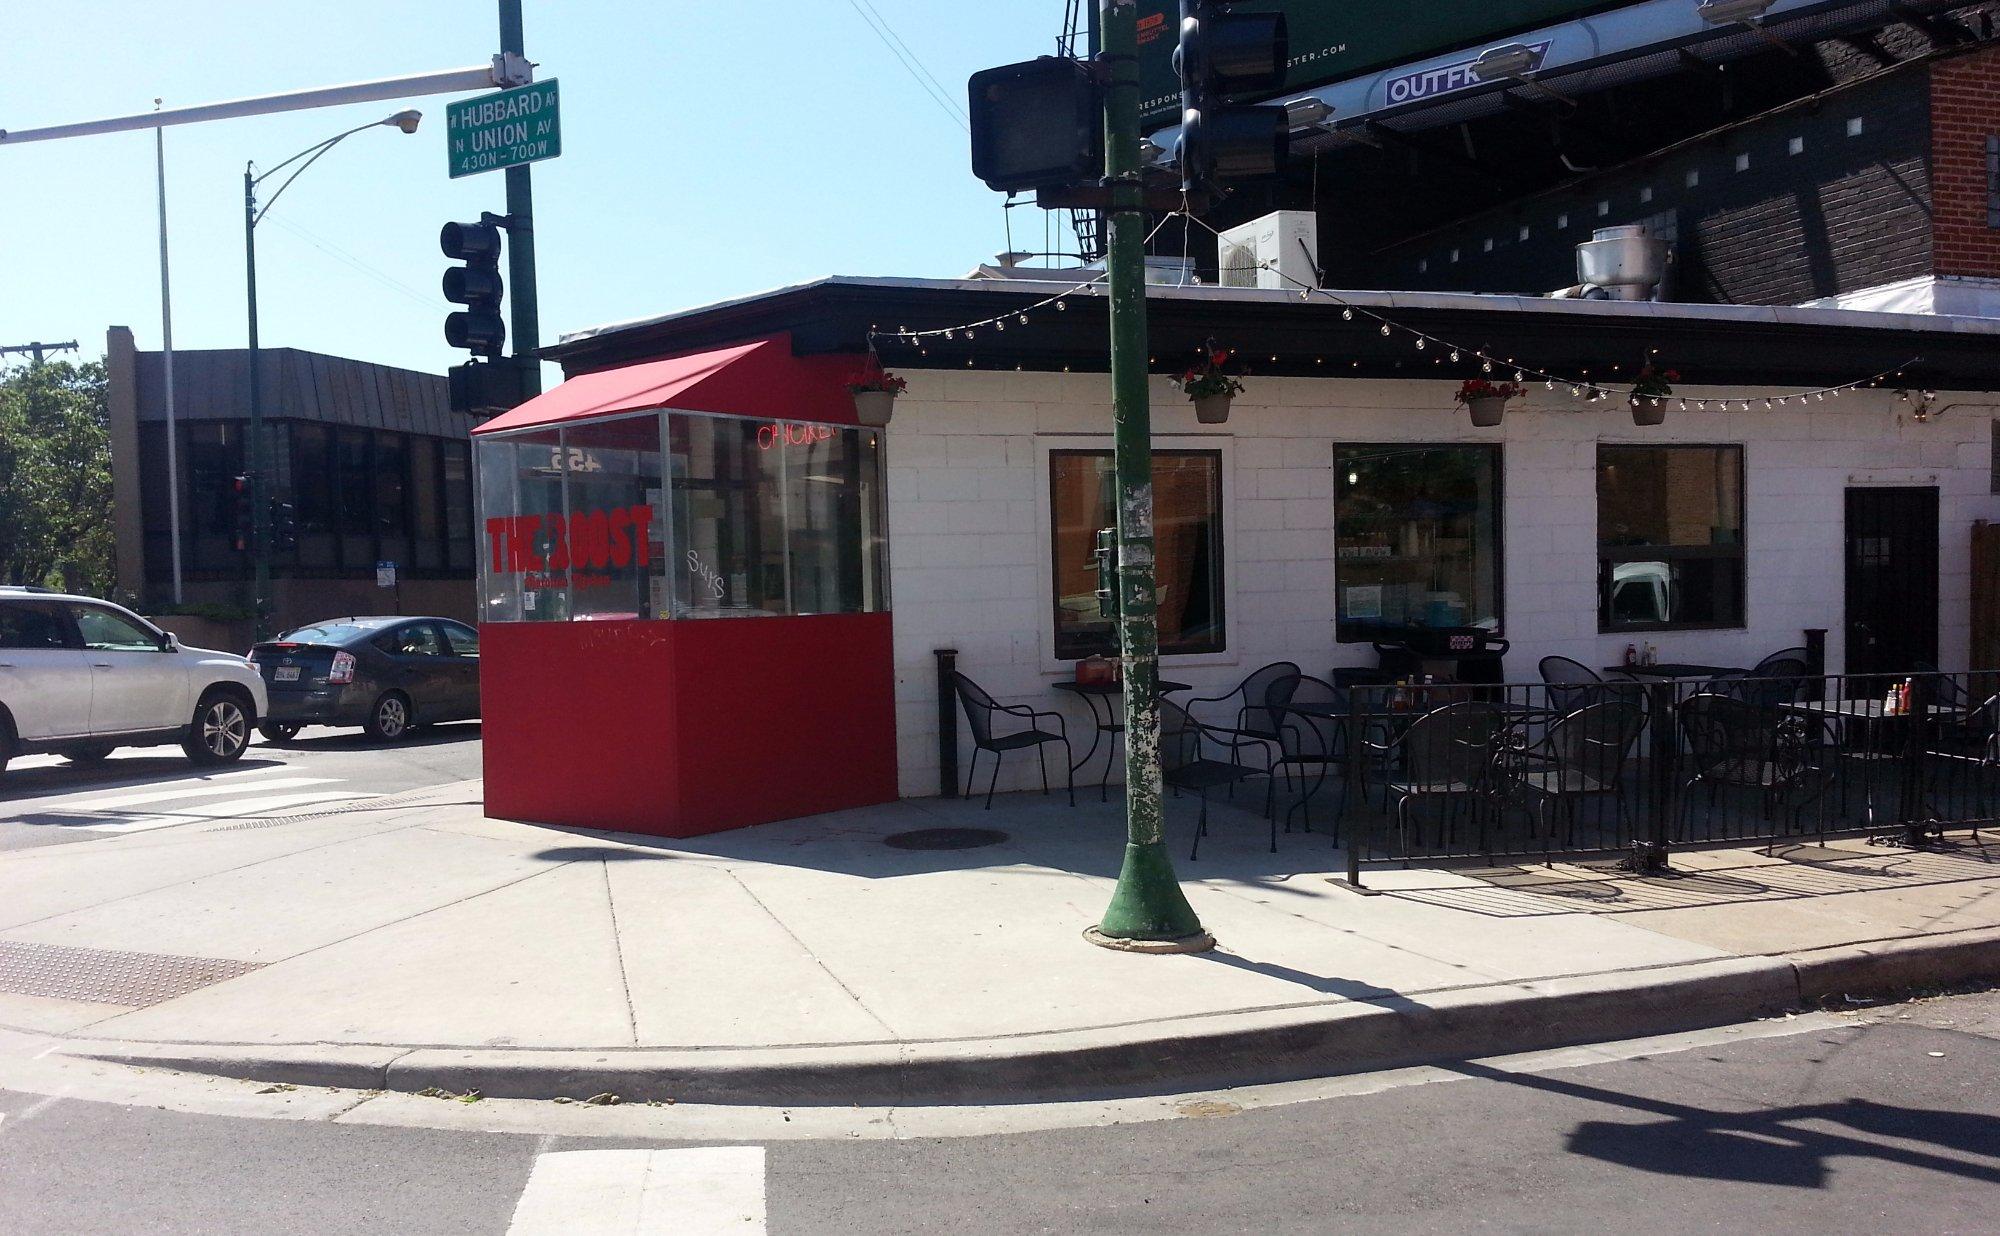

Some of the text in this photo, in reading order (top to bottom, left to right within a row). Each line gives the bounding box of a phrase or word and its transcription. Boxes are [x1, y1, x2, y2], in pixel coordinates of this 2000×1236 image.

[1287, 43, 1346, 68] STER.COM
[461, 91, 542, 130] HUBBARD
[456, 119, 552, 153] N UNION AV
[486, 515, 544, 573] THE
